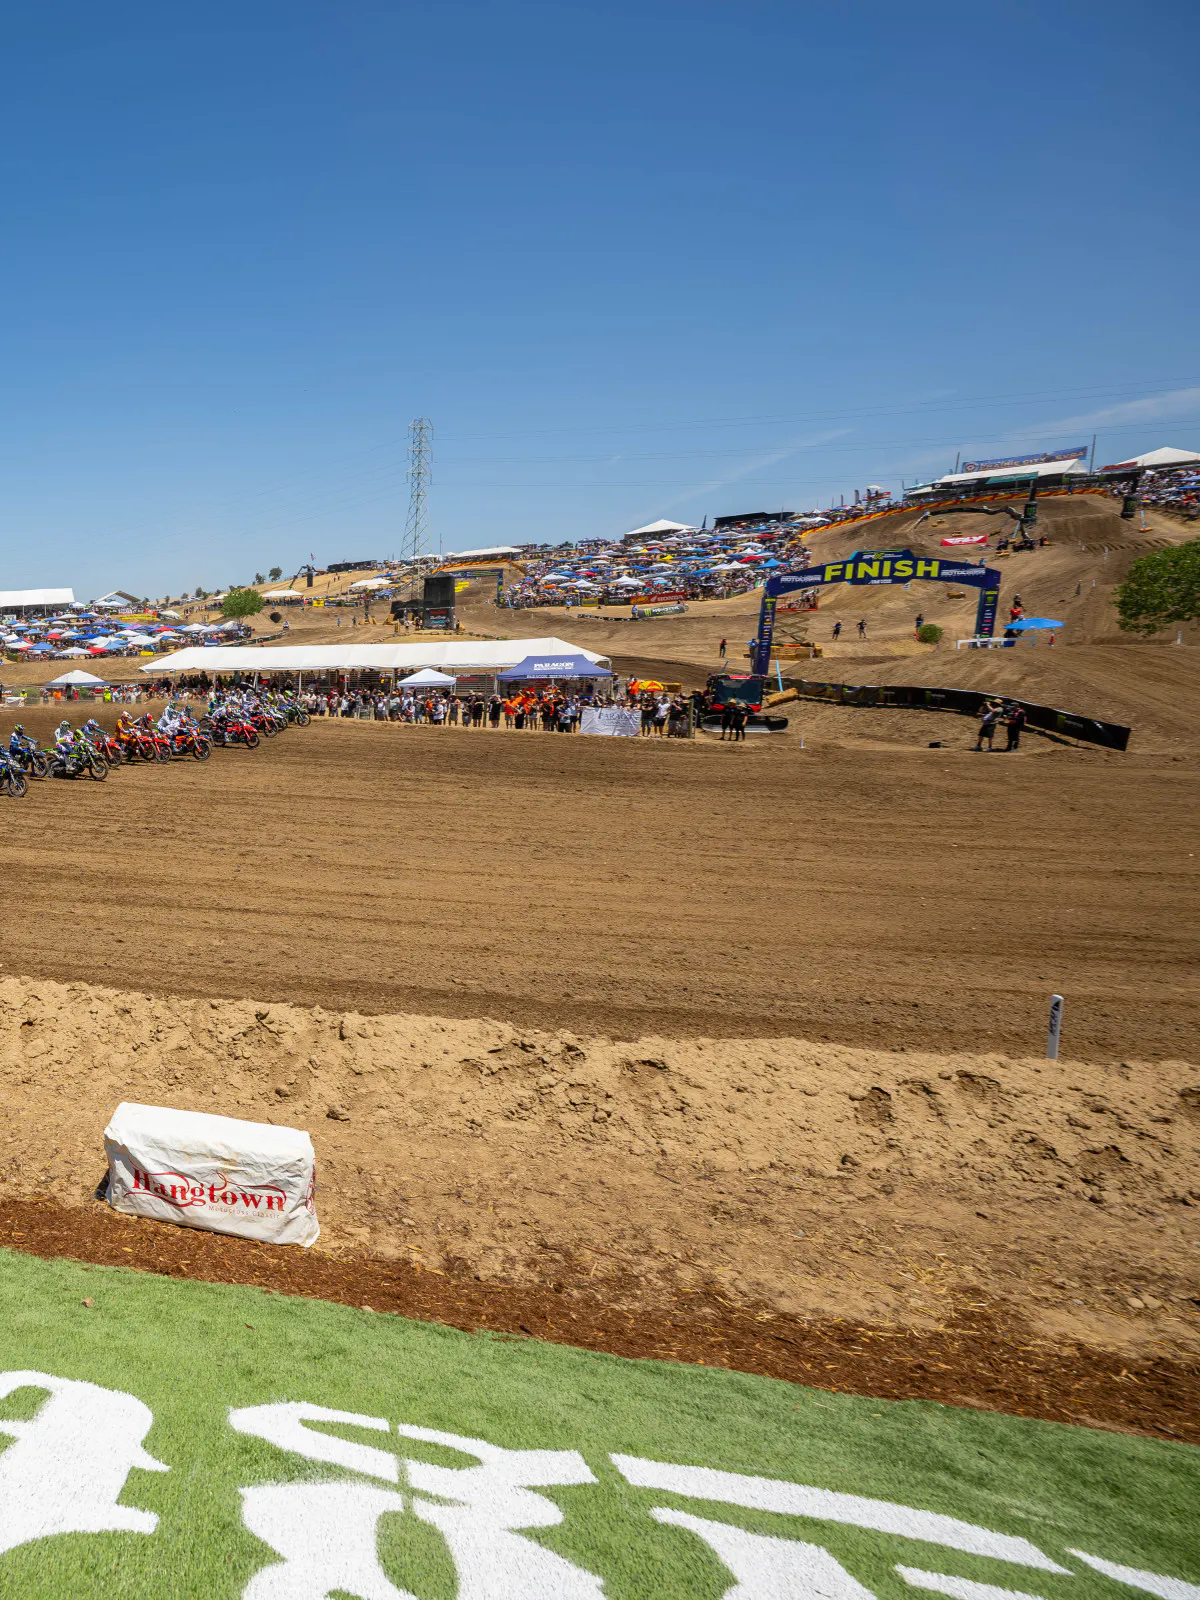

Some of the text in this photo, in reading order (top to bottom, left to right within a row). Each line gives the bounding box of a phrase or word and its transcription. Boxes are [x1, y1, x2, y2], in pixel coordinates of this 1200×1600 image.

[824, 560, 940, 582] FINISH
[123, 1158, 288, 1213] Hangtown
[208, 1203, 282, 1220] Motocross Classic
